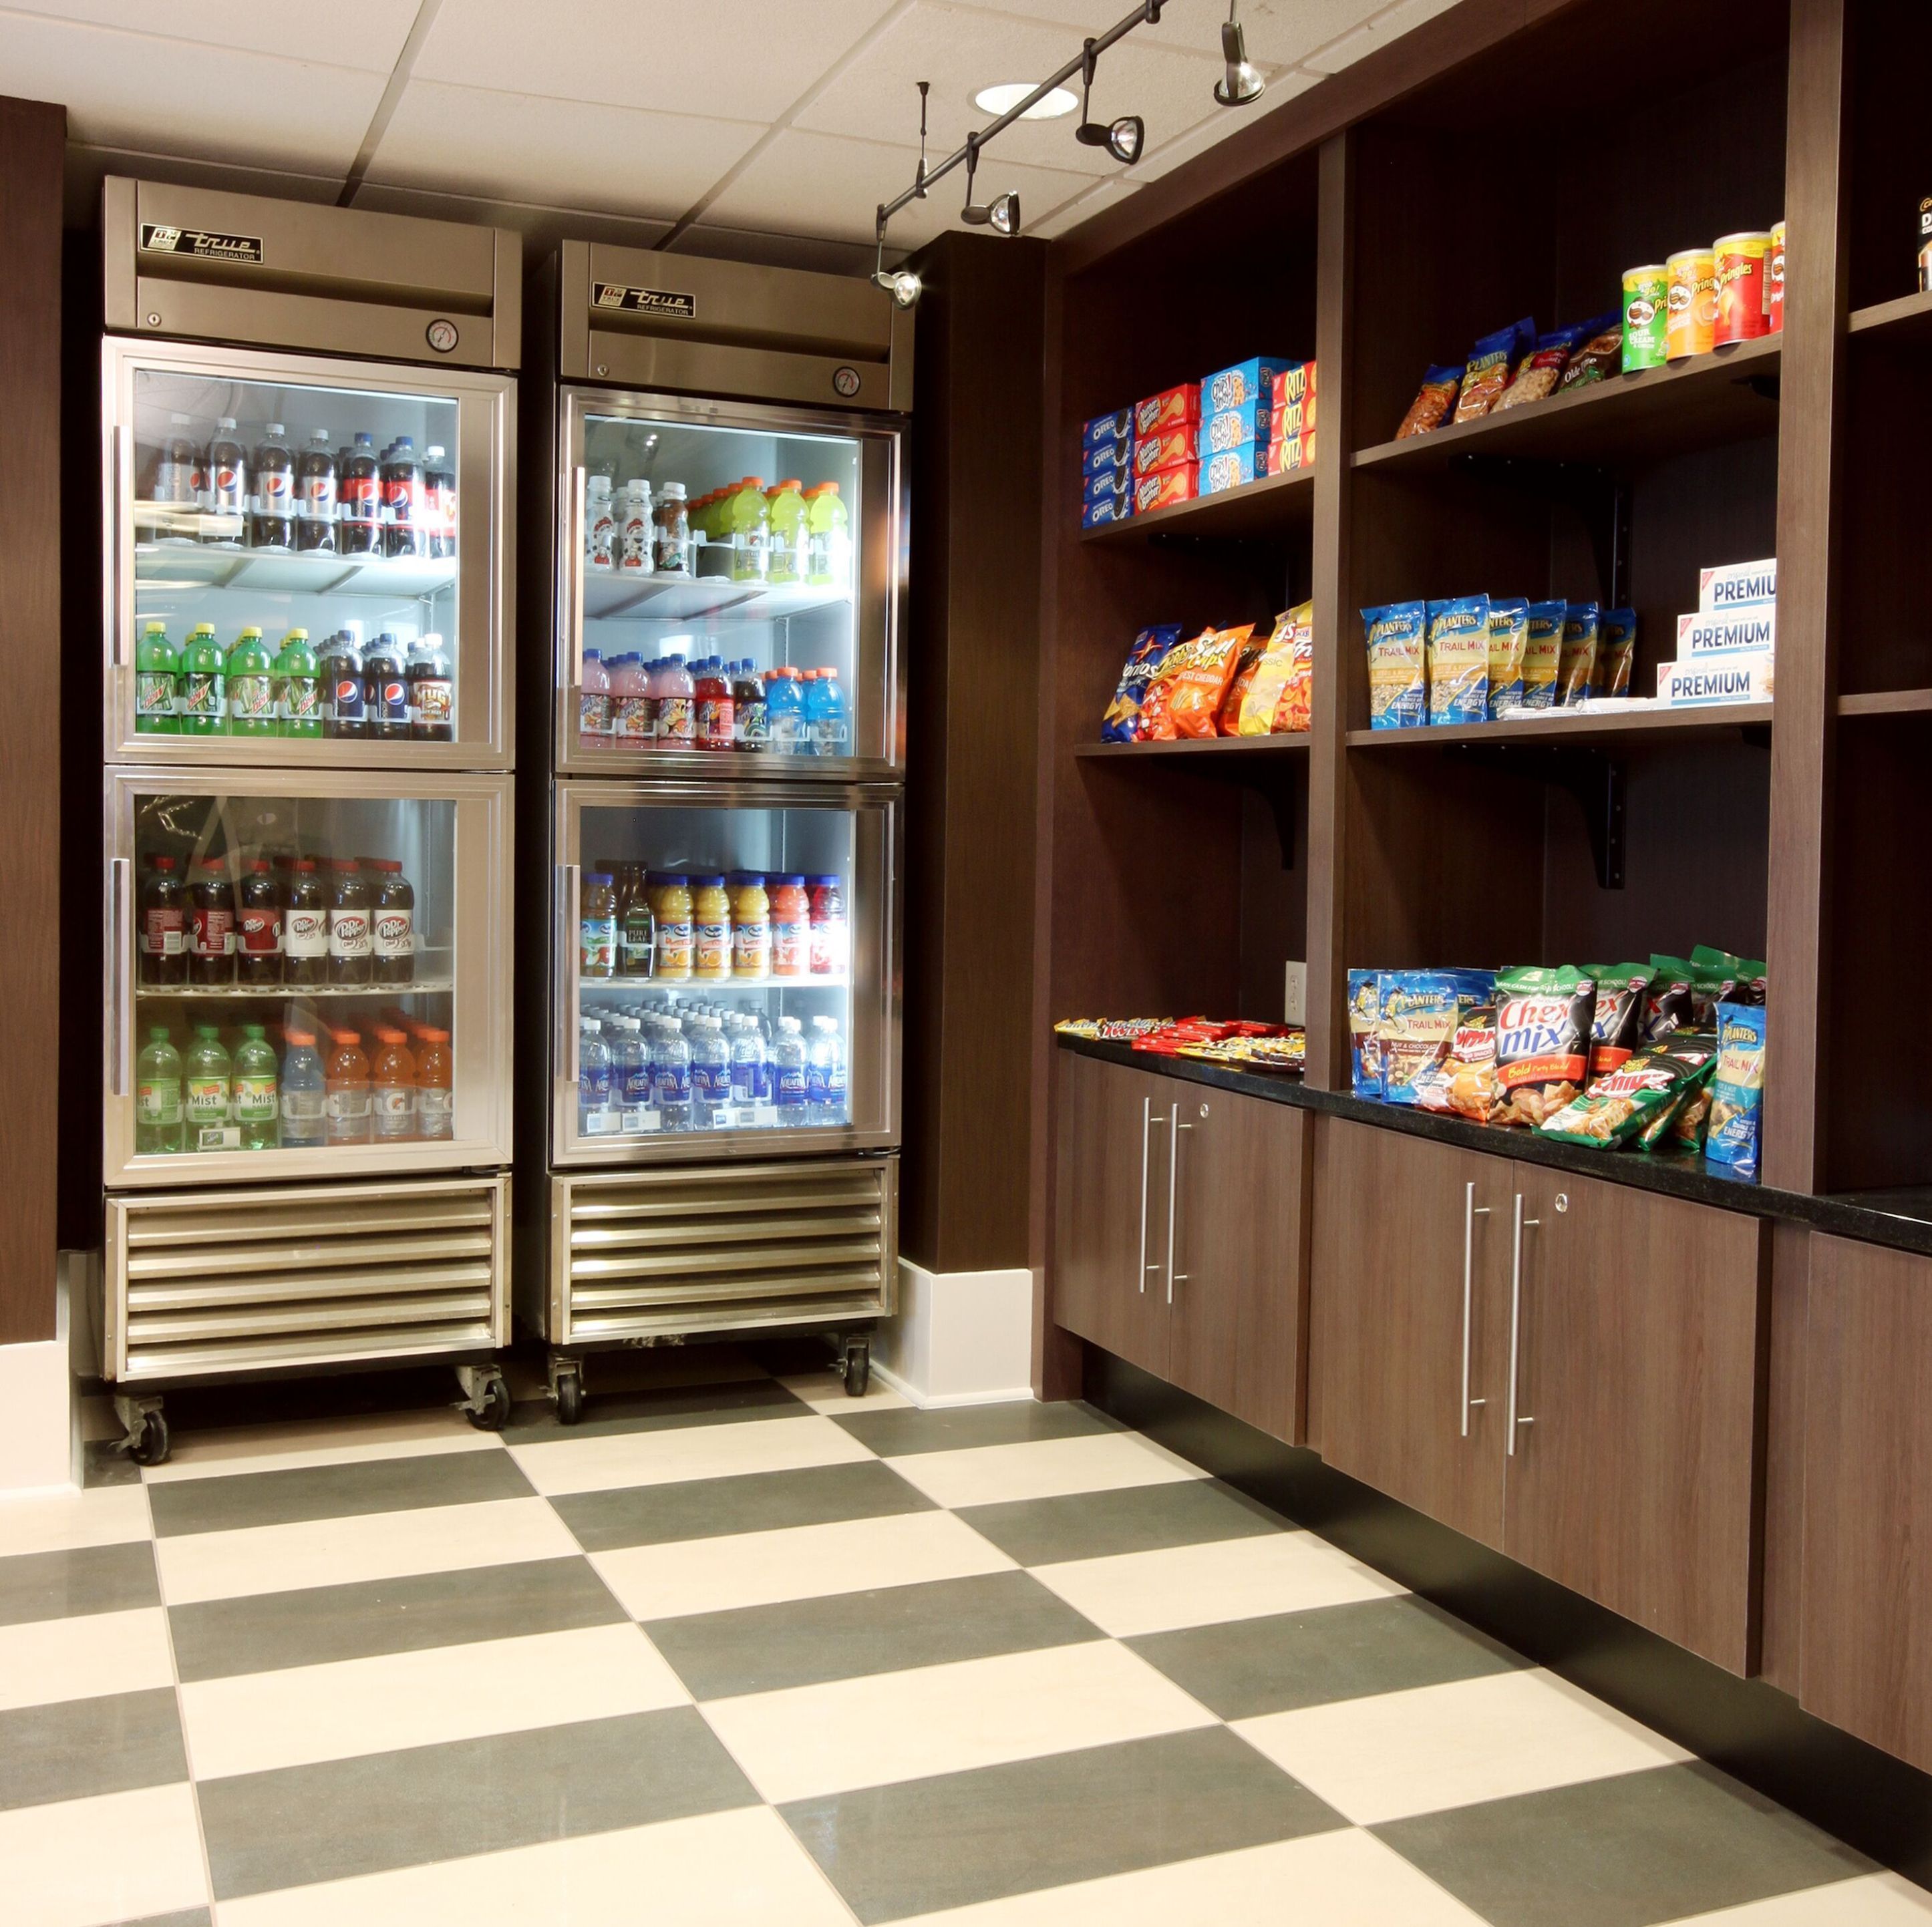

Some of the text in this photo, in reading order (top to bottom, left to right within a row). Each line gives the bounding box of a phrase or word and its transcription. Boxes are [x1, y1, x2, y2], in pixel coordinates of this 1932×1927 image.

[194, 248, 255, 260] REFRIGERATOR
[1720, 262, 1753, 289] Pringles
[637, 304, 689, 315] REFRIGERATOR
[1466, 350, 1508, 374] PLANTERS
[1286, 368, 1306, 405] RITZ
[1093, 419, 1115, 440] OREO
[1283, 404, 1302, 439] RITZ
[1093, 448, 1115, 468] OREO
[1281, 439, 1301, 472] RITZ
[1093, 475, 1114, 495] OREO
[1092, 503, 1114, 522] OREO
[1378, 621, 1412, 636] PLANTERS
[1440, 614, 1476, 631] PLANTERS
[1692, 621, 1770, 650] PREMIUM
[1378, 647, 1420, 657] TRAIL MIX
[1440, 640, 1484, 652] TRAIL MIX
[1501, 642, 1520, 652] MIX
[1539, 645, 1556, 655] MIX
[1573, 647, 1589, 656] MIX
[1194, 673, 1224, 687] CHEDDAR
[1671, 671, 1750, 697] PREMIUM
[417, 688, 448, 705] MUG
[1454, 698, 1486, 707] ENERGY!
[341, 922, 365, 938] Pepper
[350, 920, 359, 928] Dr
[383, 922, 407, 937] Pepper
[392, 920, 401, 928] Dr
[1500, 1000, 1570, 1030] Chex
[1407, 1019, 1451, 1029] TRAIL MIX
[1500, 1020, 1567, 1056] mix
[1726, 1025, 1758, 1042] PLANTERS
[1391, 1041, 1402, 1049] NUT
[1508, 1062, 1531, 1079] Bold
[1723, 1055, 1759, 1074] TRAIL MIX
[192, 1095, 217, 1105] Mist
[252, 1093, 275, 1104] Mist
